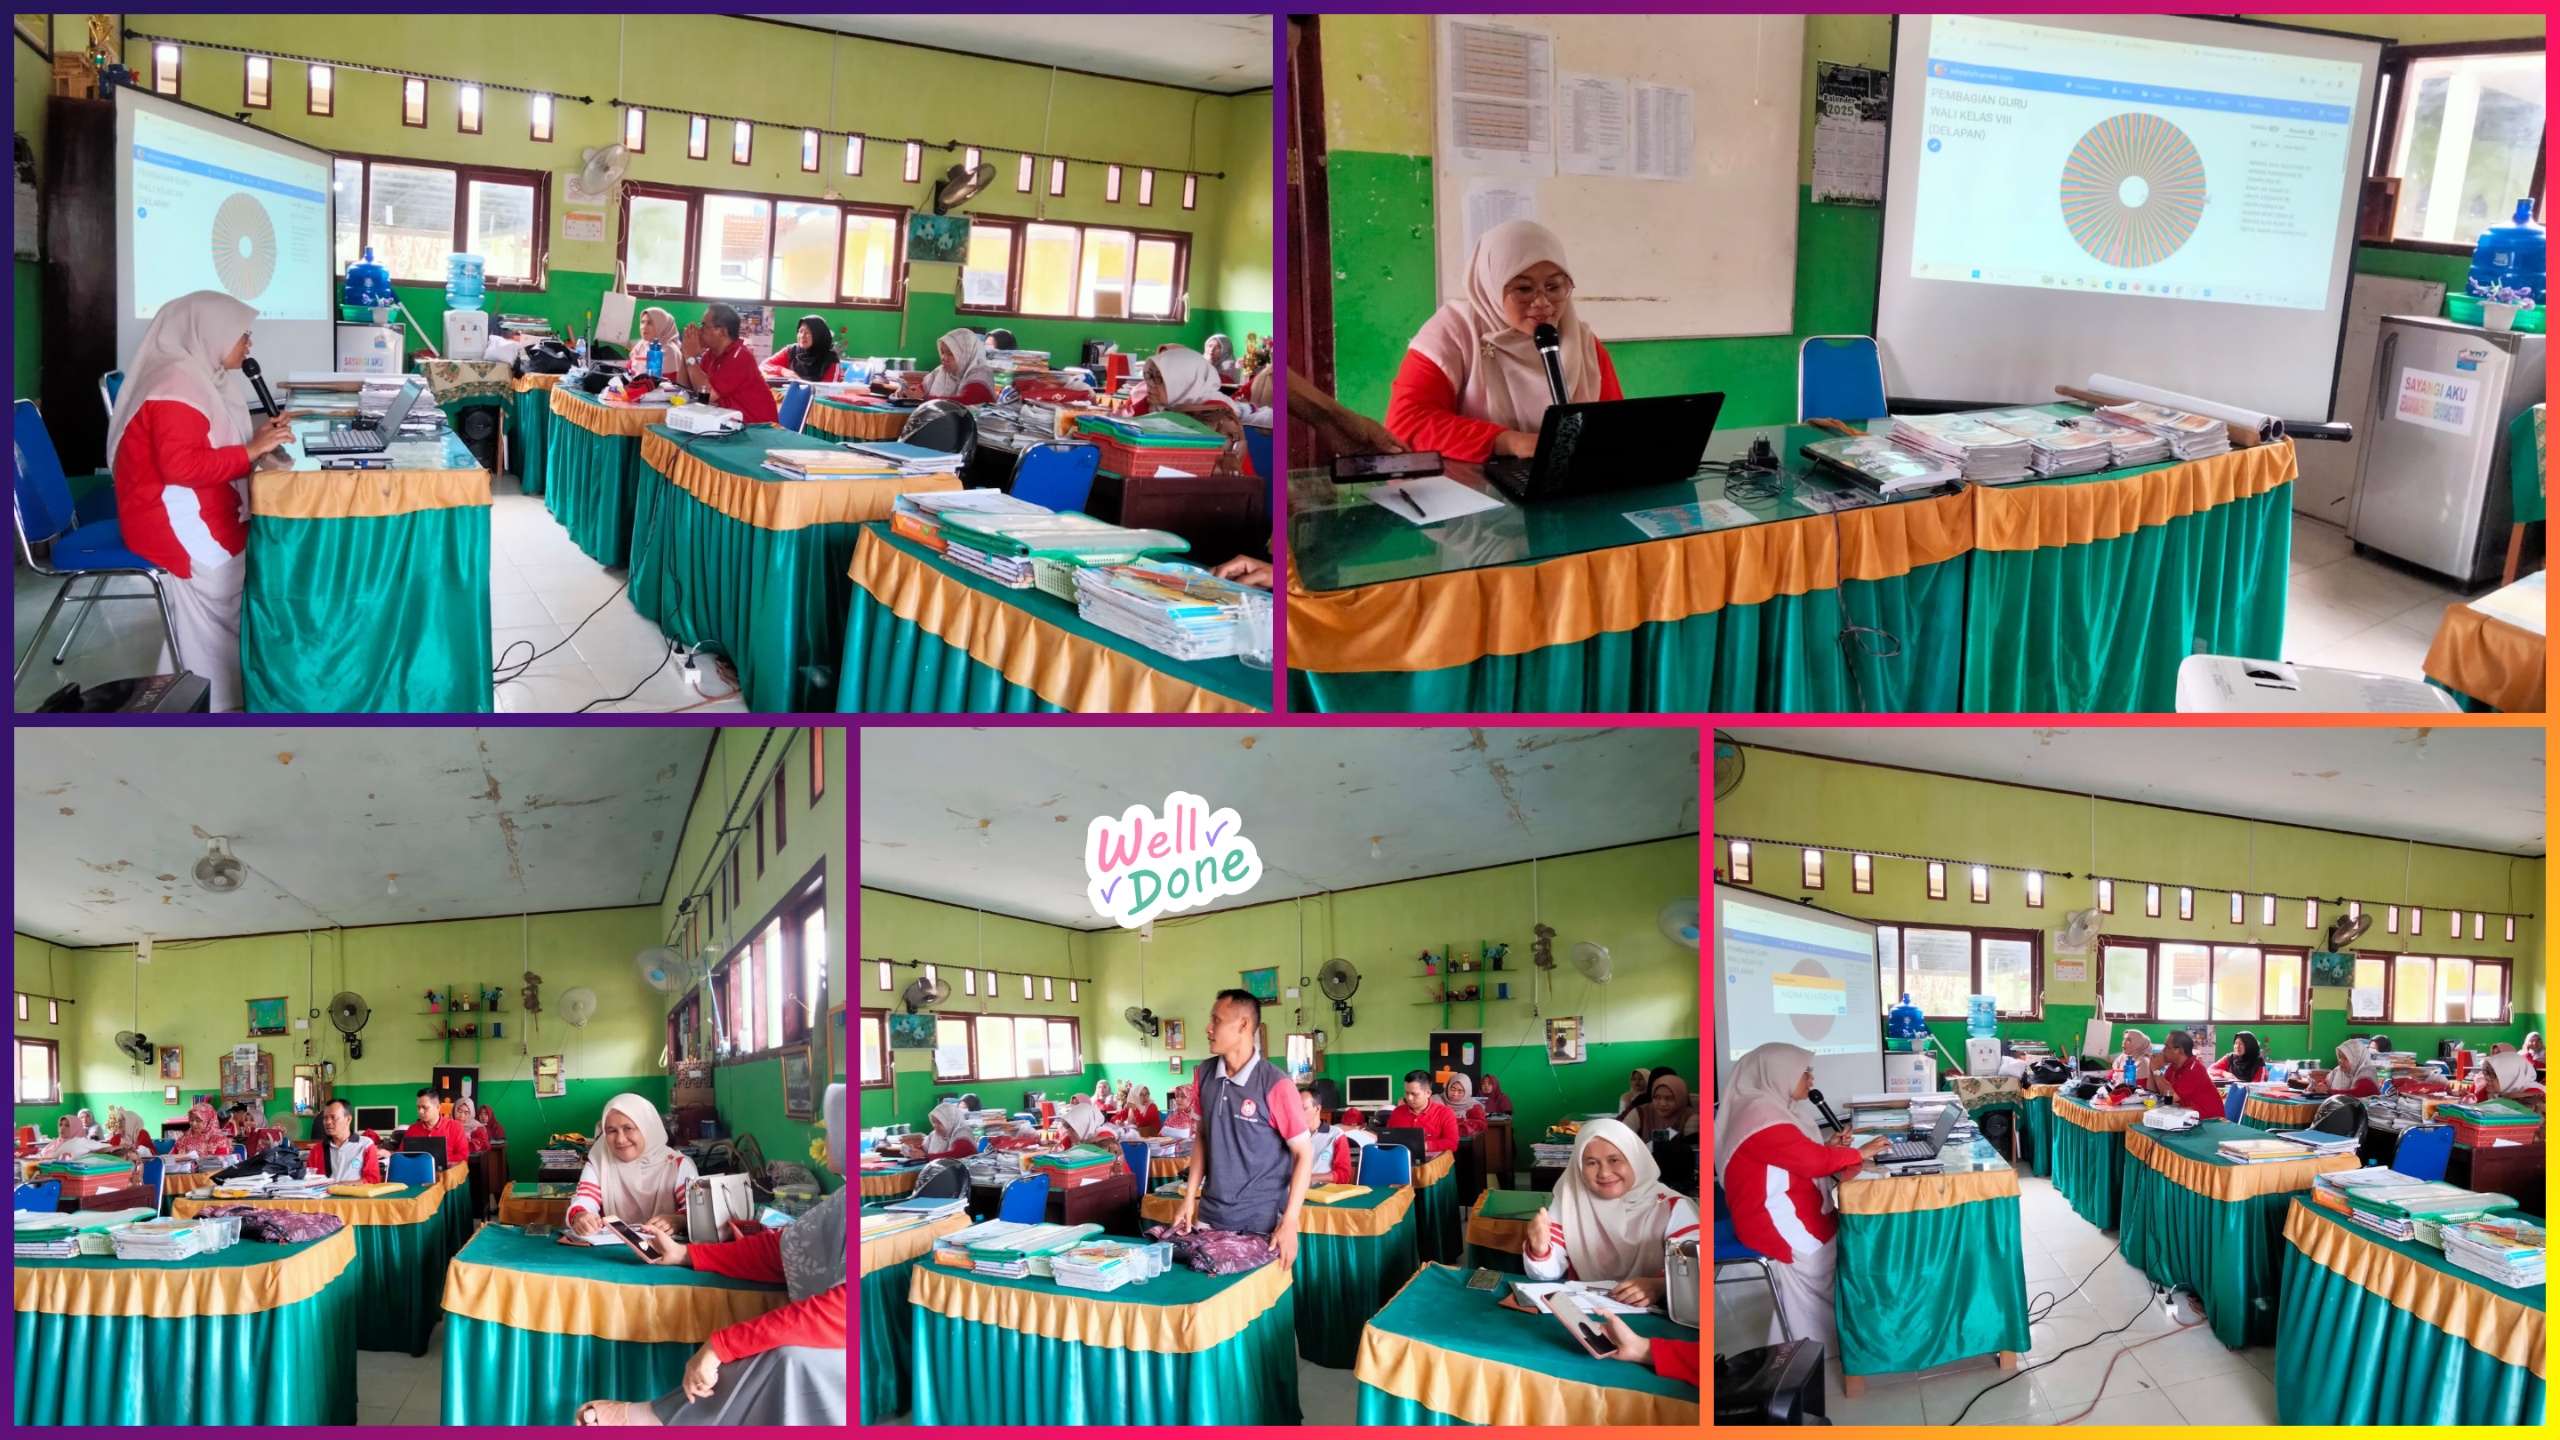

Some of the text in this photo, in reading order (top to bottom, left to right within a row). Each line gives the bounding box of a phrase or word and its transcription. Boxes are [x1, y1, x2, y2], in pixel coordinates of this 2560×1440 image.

[1823, 93, 1856, 104] Kalender
[1931, 87, 2028, 109] PEMBAGIAN GURU
[1827, 104, 1855, 117] 2025
[1930, 106, 2012, 125] WALI KELAS VIII
[1928, 123, 1986, 141] (DELAPAN)
[344, 357, 384, 366] SAYANGI AKU
[2405, 377, 2468, 401] SAYANGI AKU
